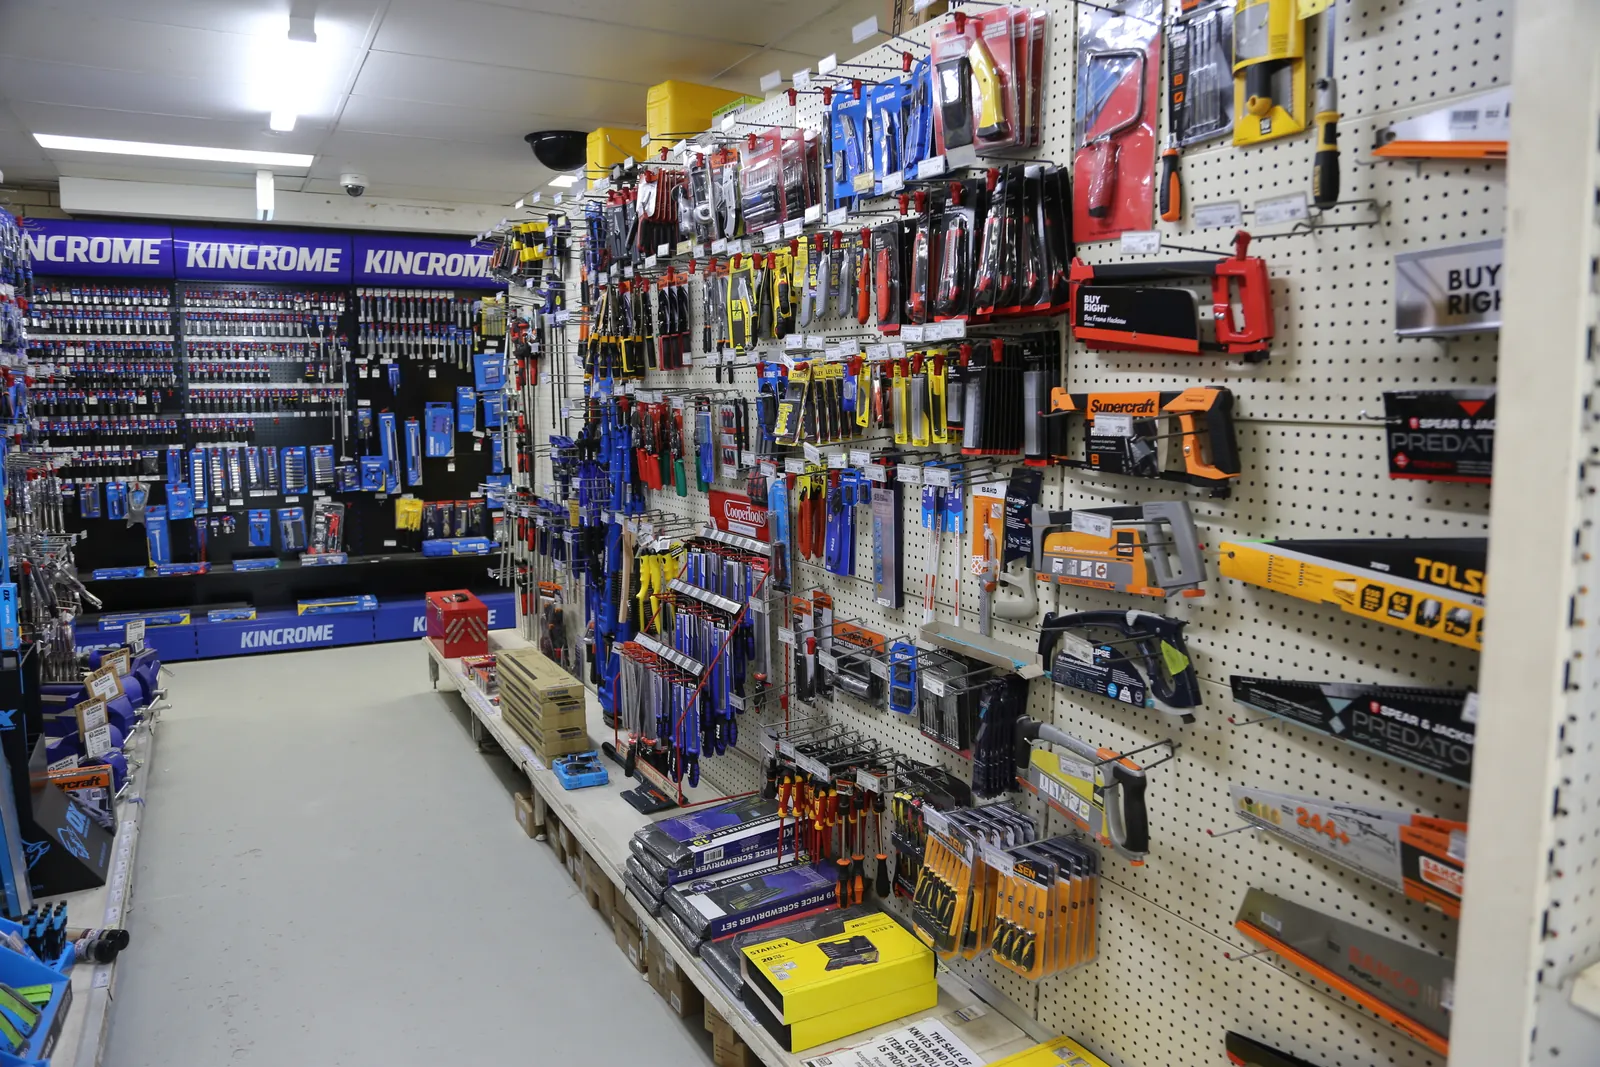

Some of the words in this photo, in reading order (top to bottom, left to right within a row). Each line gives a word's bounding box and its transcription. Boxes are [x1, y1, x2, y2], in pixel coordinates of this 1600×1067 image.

[186, 241, 343, 273] KINCROME
[1448, 263, 1502, 291] BUY
[1084, 295, 1101, 304] BUY
[1084, 303, 1109, 313] RIGHT
[1090, 398, 1156, 413] Supercraft
[1420, 418, 1460, 429] SPEAR
[725, 503, 766, 525] CooperTools
[241, 623, 333, 649] KINCROME
[1380, 705, 1420, 727] SPEAR
[1420, 719, 1430, 730] &
[755, 848, 778, 858] PIECE
[696, 853, 753, 873] SCREWDRIVER
[677, 868, 693, 878] SET
[801, 896, 825, 907] PIECE
[826, 890, 836, 899] 19
[740, 901, 799, 926] SCREWDRIVER
[720, 922, 738, 931] SET
[750, 941, 790, 956] STANLEY
[1348, 944, 1419, 997] BAHCO
[877, 1044, 889, 1053] IS
[885, 1036, 909, 1055] ITEMS
[904, 1053, 918, 1065] TO
[908, 1026, 935, 1049] KNIVES
[930, 1048, 949, 1061] AND
[930, 1031, 946, 1044] THE
[941, 1041, 962, 1059] SALE
[958, 1056, 973, 1067] OF
